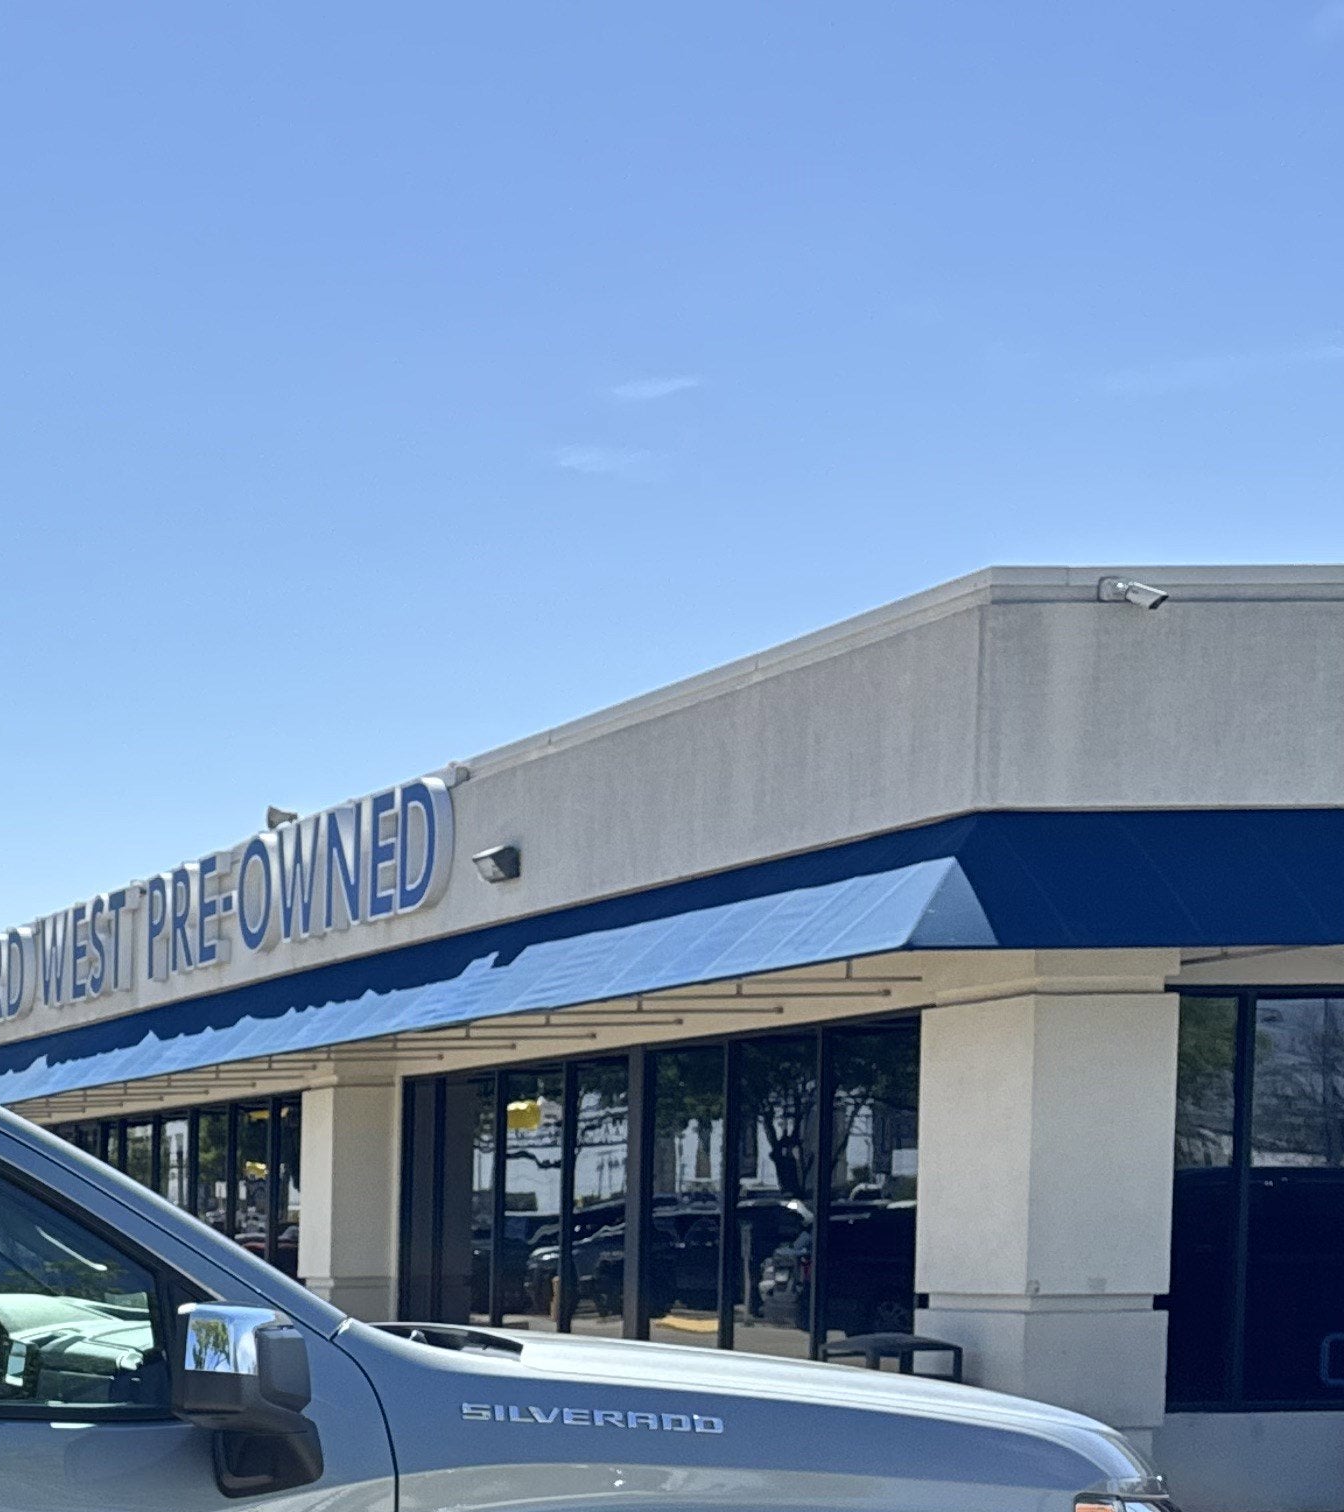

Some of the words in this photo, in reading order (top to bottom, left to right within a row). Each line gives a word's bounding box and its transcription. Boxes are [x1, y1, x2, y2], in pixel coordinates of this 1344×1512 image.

[40, 890, 126, 1006] WEST
[147, 780, 442, 980] PRE-OWNED
[461, 1402, 724, 1434] SILVERADO
